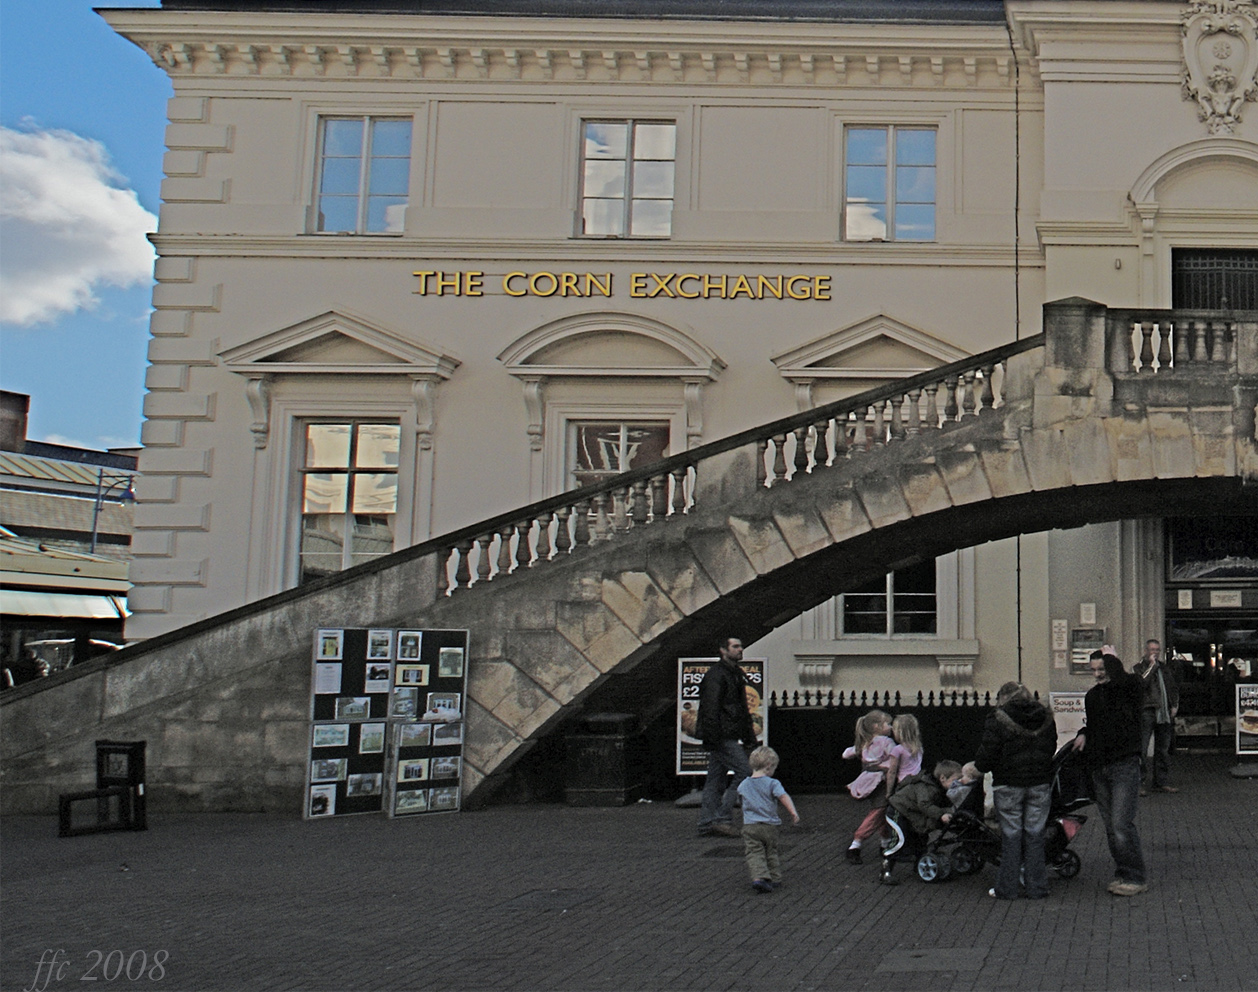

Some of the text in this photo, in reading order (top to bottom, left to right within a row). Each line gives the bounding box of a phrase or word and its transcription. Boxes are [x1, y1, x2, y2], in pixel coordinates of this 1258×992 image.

[413, 271, 833, 300] THE CORN EXCHANGE
